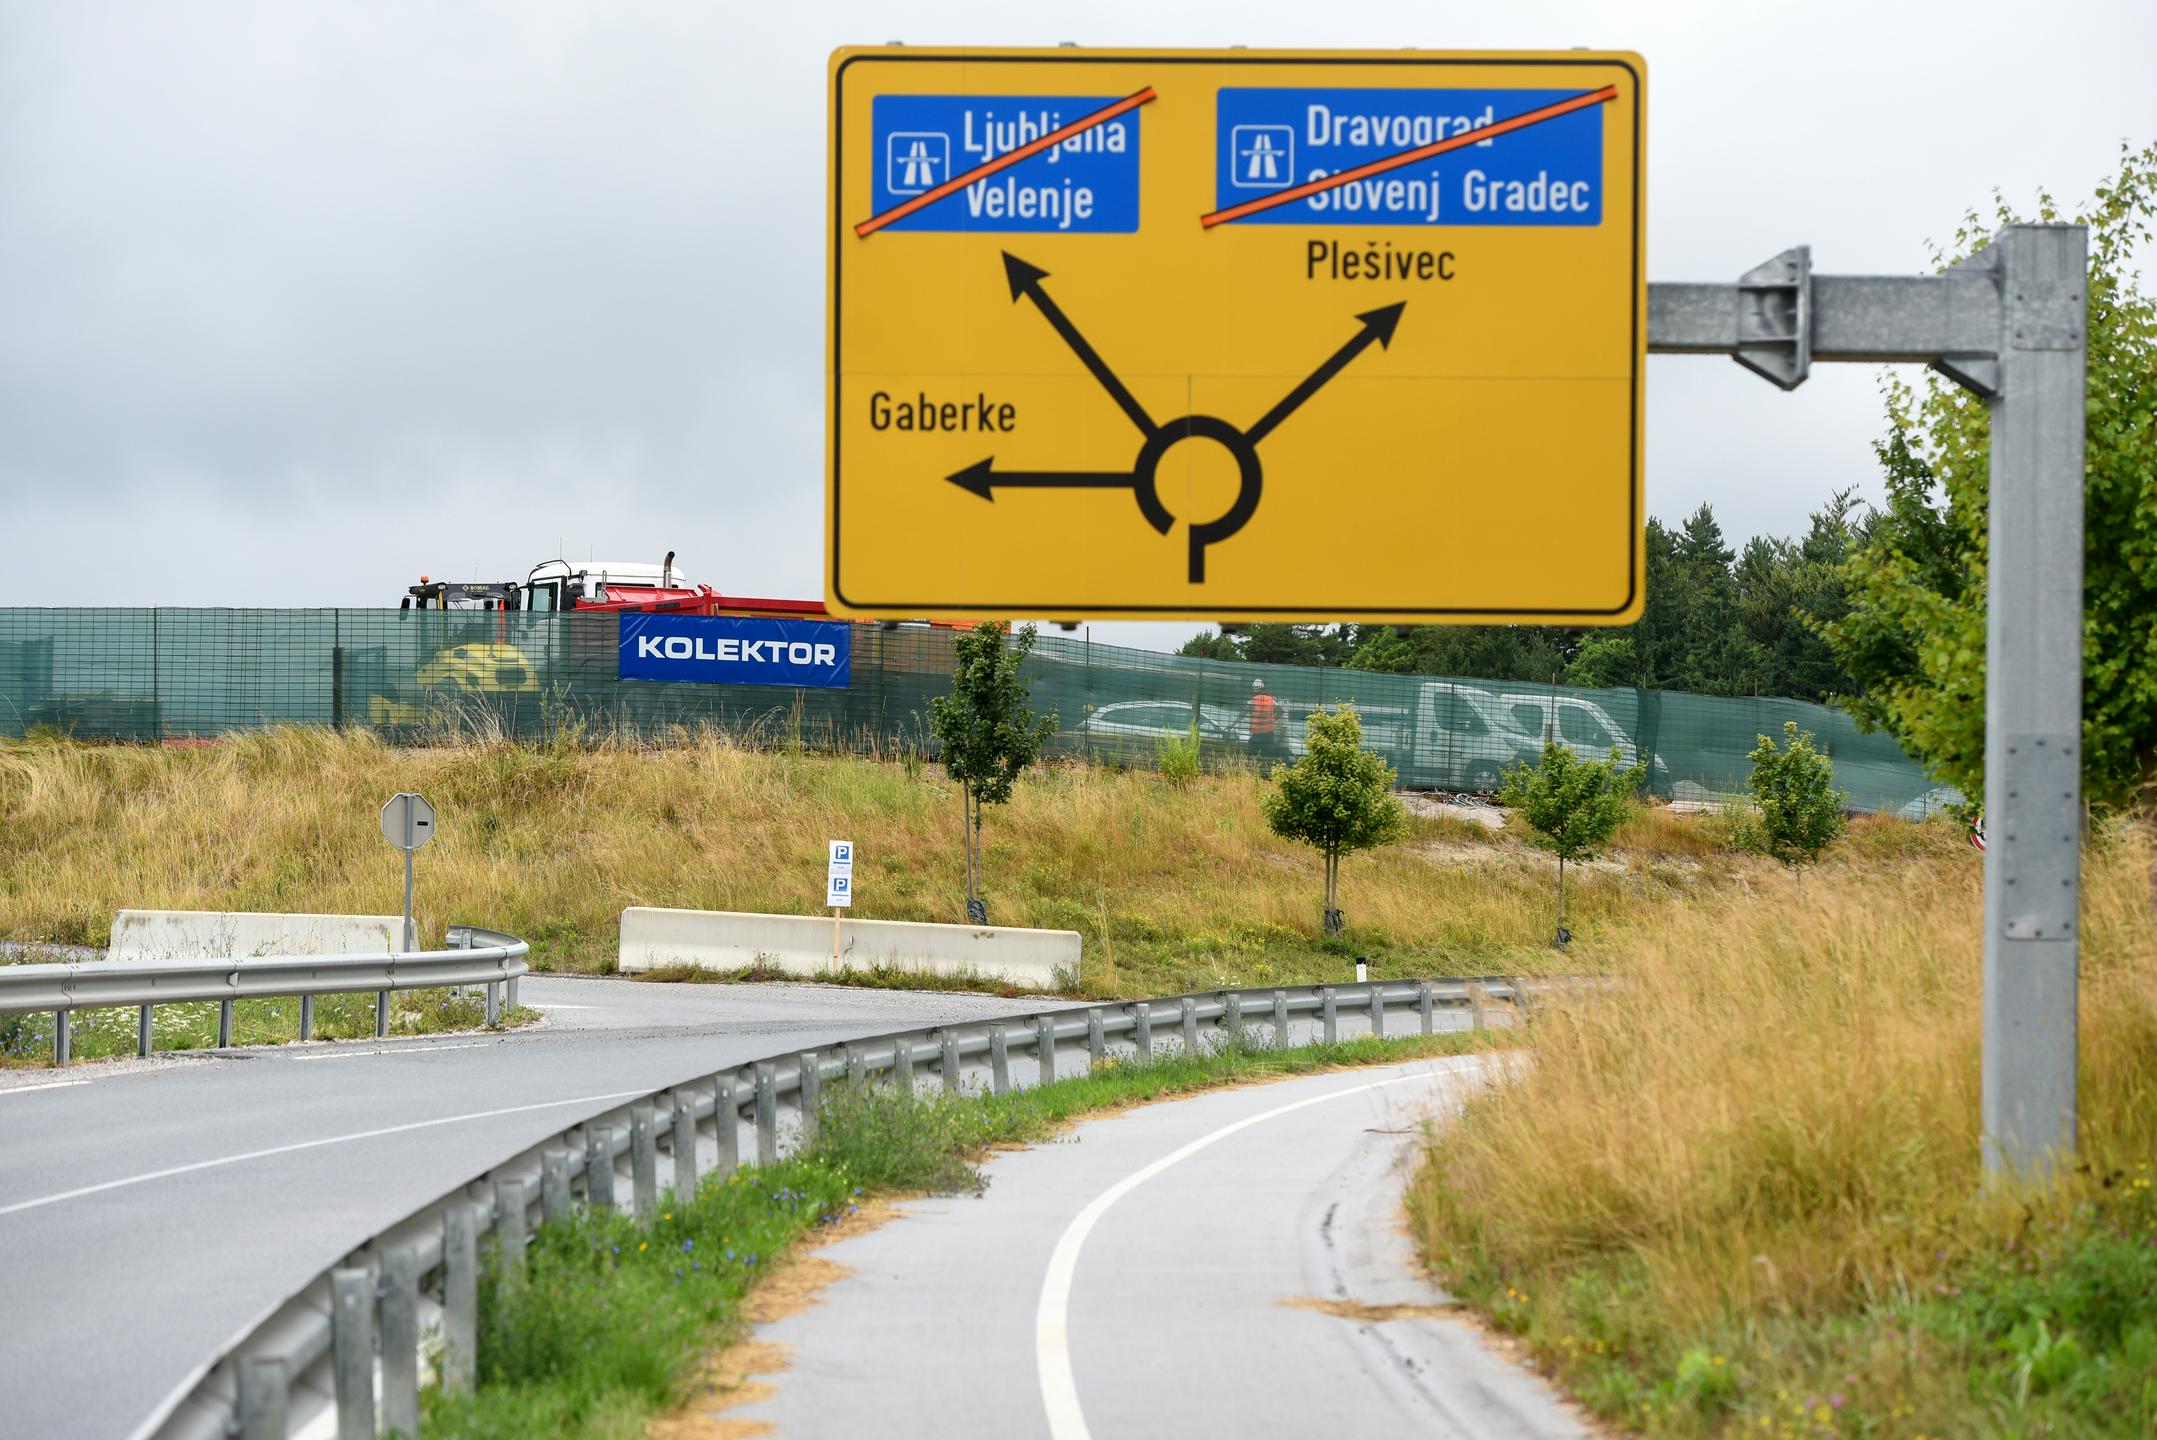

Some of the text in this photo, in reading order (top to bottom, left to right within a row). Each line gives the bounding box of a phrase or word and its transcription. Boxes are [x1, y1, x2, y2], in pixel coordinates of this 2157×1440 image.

[964, 110, 1126, 164] Ljubljana
[1307, 104, 1494, 148] Dravograd
[966, 176, 1094, 229] Velenje
[1307, 168, 1590, 222] Slovenj Gradec
[1307, 240, 1456, 281] Plešivec
[870, 391, 1016, 432] Gaberke
[638, 635, 836, 667] KOLEKTOR
[837, 846, 848, 859] P
[835, 878, 846, 891] P
